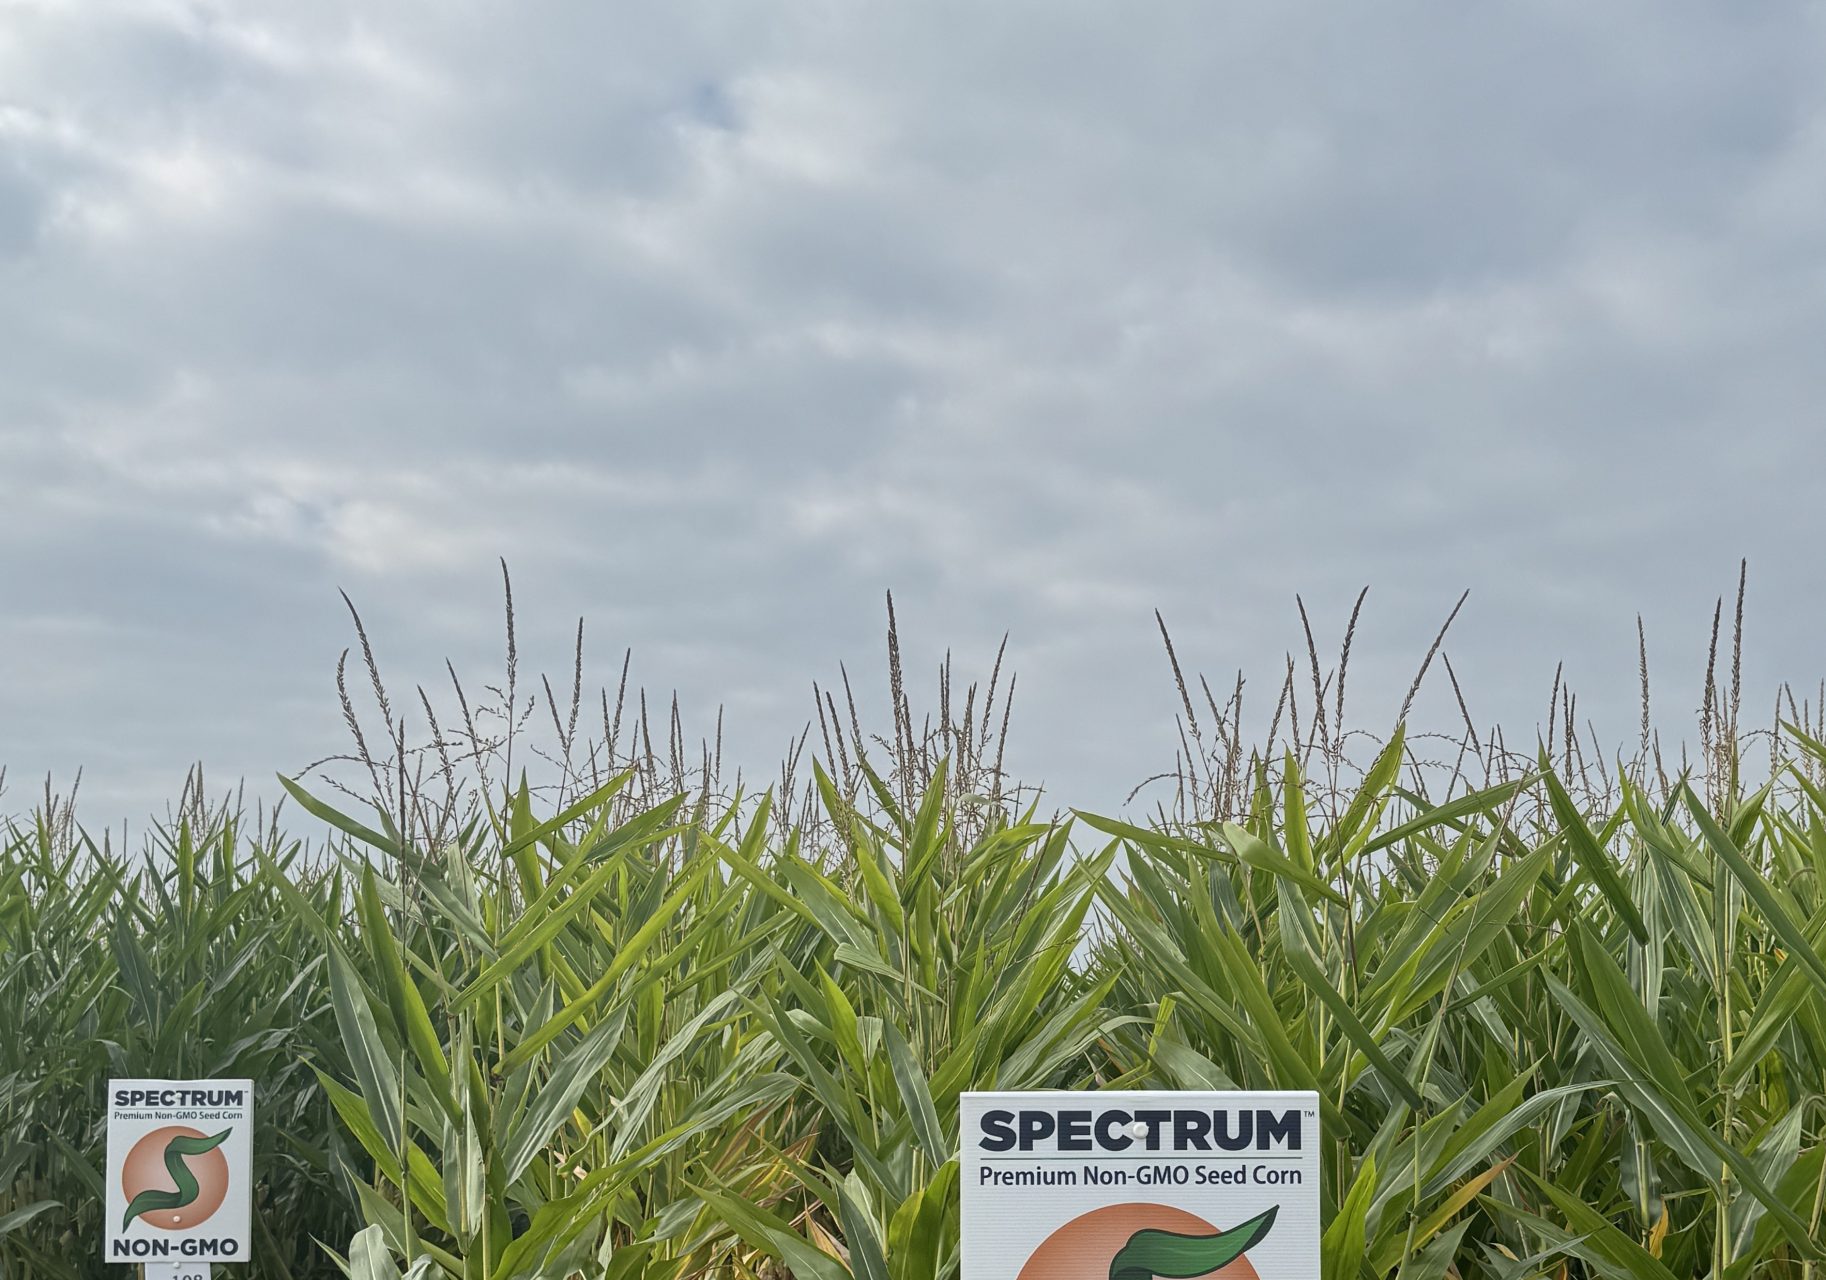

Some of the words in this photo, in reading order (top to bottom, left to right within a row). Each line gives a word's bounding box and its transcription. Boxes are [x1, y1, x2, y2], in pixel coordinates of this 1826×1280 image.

[114, 1090, 243, 1107] SPECTRUM
[114, 1111, 153, 1120] Premium
[155, 1111, 197, 1120] Non-GMO
[199, 1111, 221, 1120] Seed
[222, 1111, 243, 1120] Corn
[978, 1110, 1302, 1151] SPECTRUM
[980, 1166, 1077, 1186] Premium
[1084, 1165, 1189, 1185] Non-GMO
[1195, 1165, 1247, 1185] Seed
[1252, 1165, 1302, 1185] Corn
[113, 1239, 238, 1256] NON-GMO
